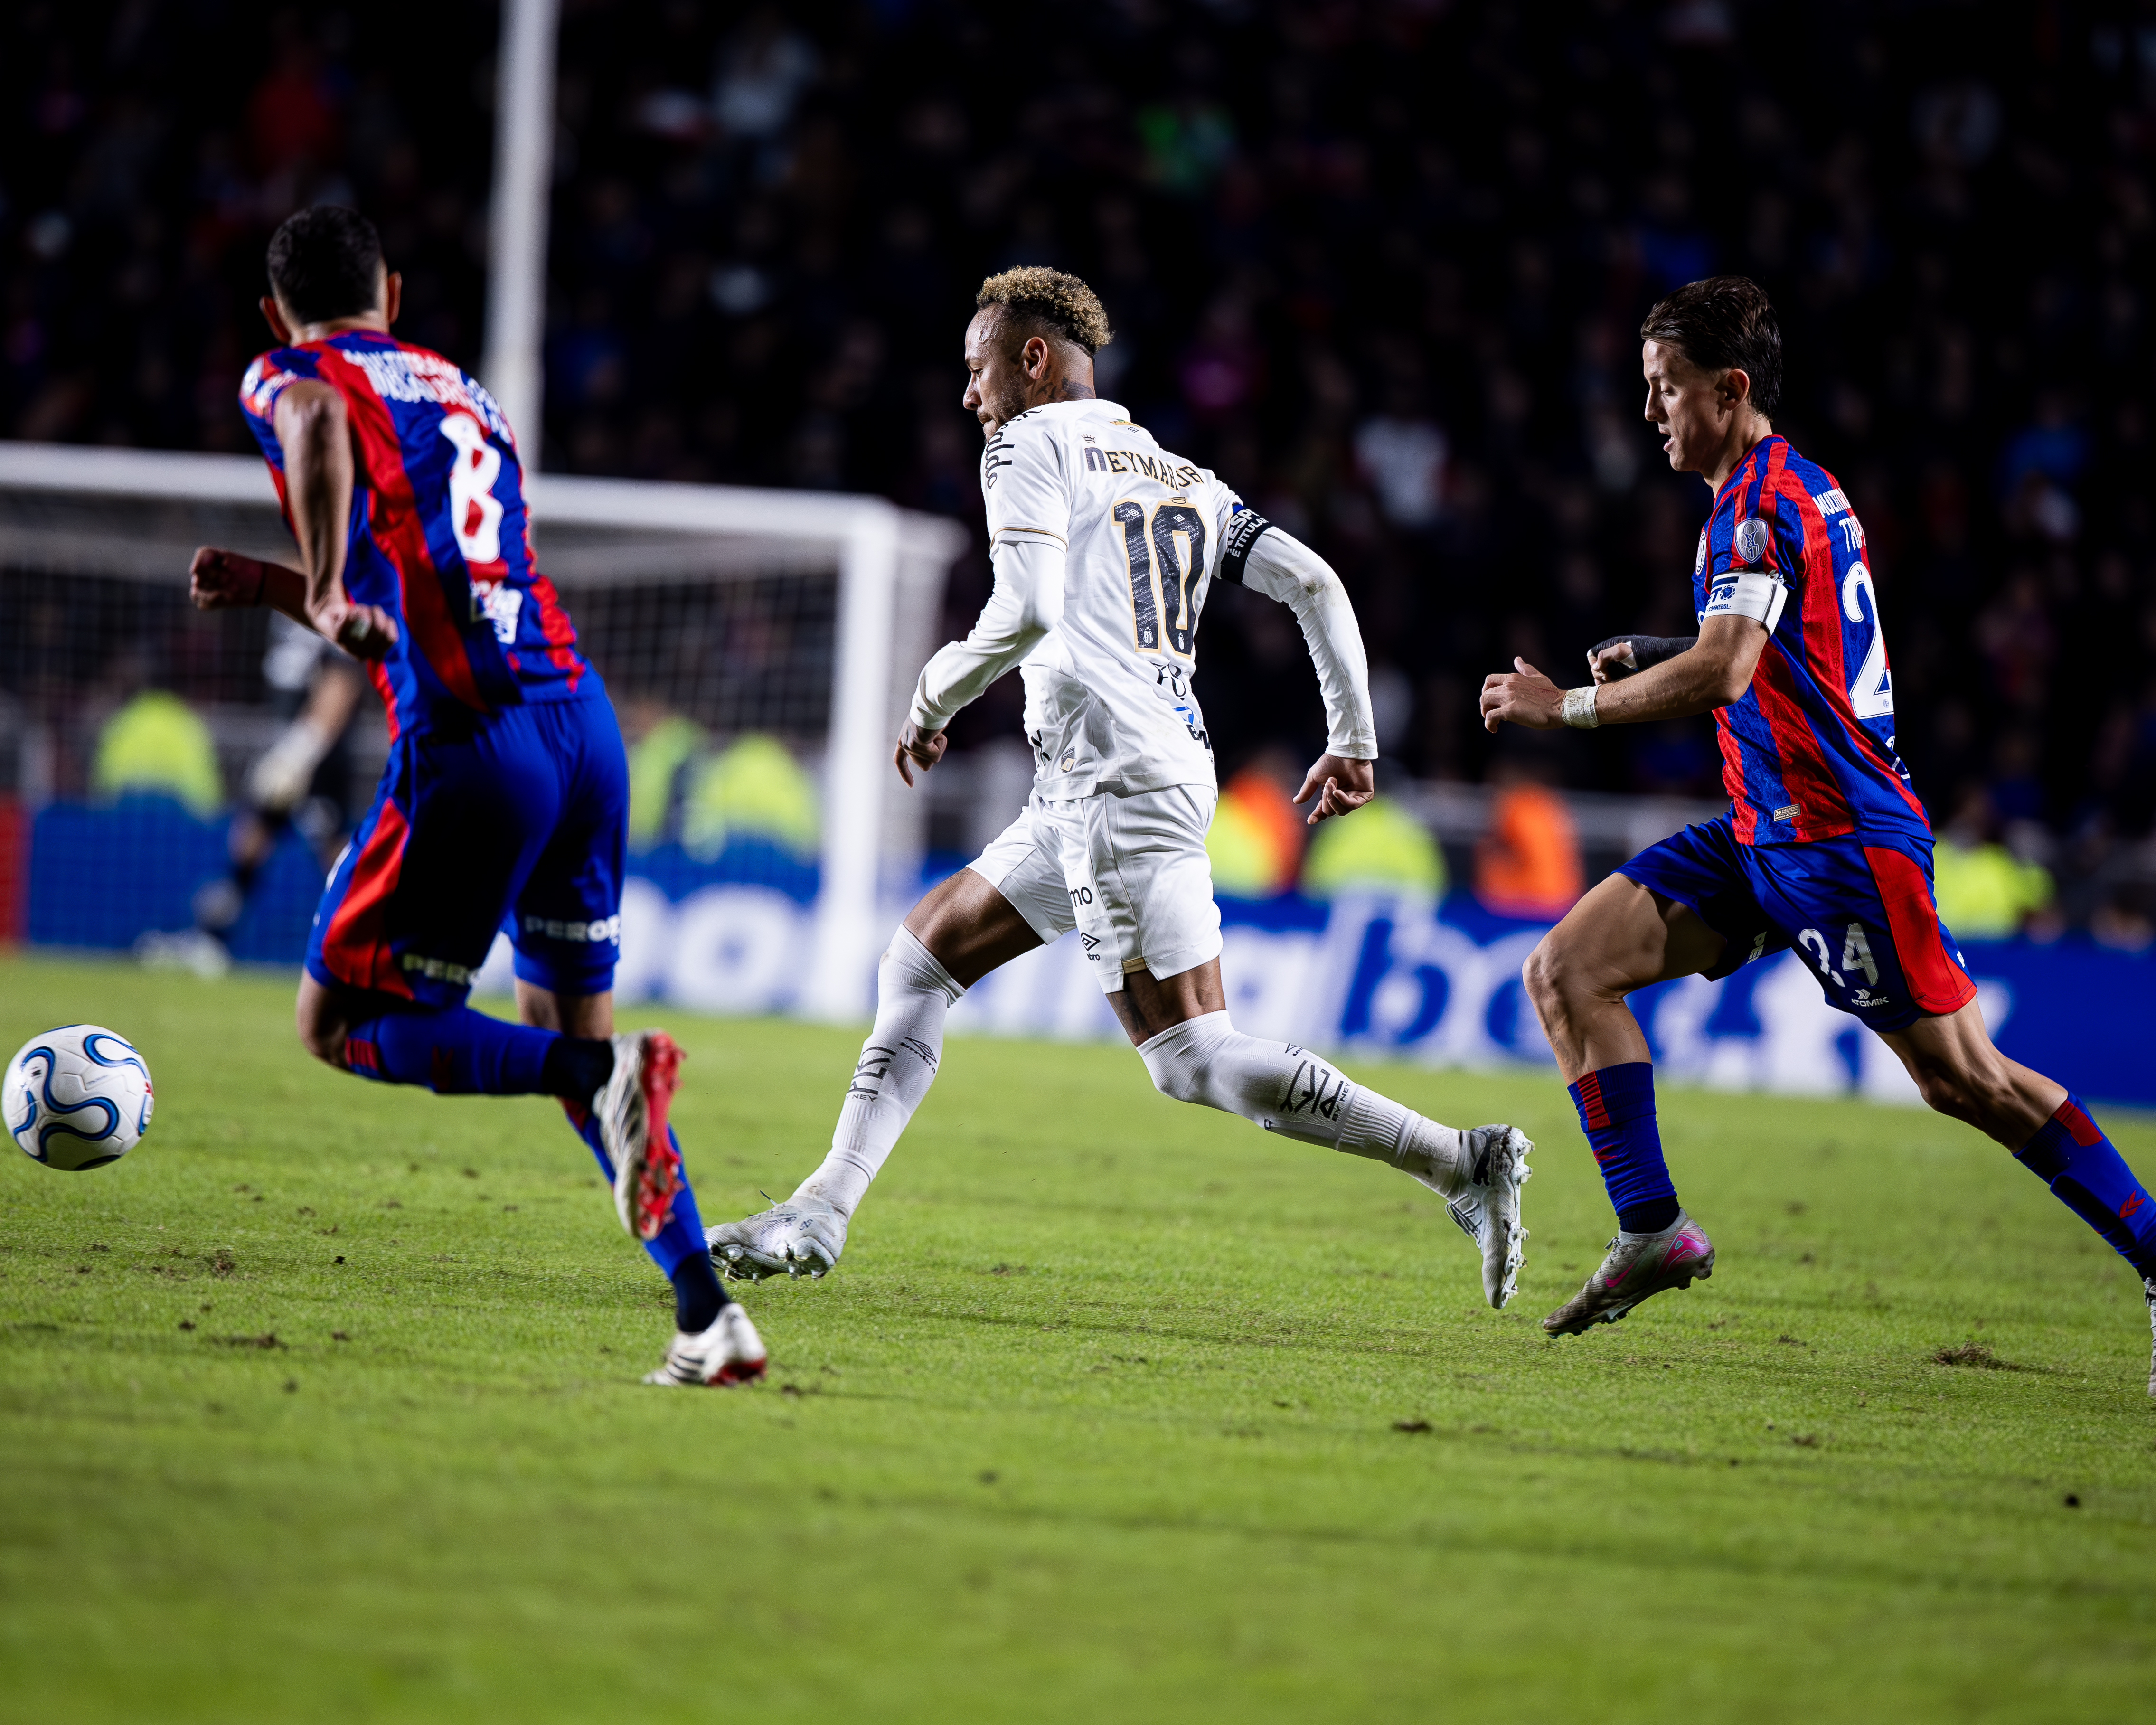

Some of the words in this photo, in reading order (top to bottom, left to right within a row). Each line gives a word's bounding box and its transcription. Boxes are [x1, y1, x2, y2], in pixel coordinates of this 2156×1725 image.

[439, 411, 503, 564] 8
[985, 410, 1042, 489] aldo
[1110, 498, 1207, 660] 10
[1841, 561, 1894, 720] 2
